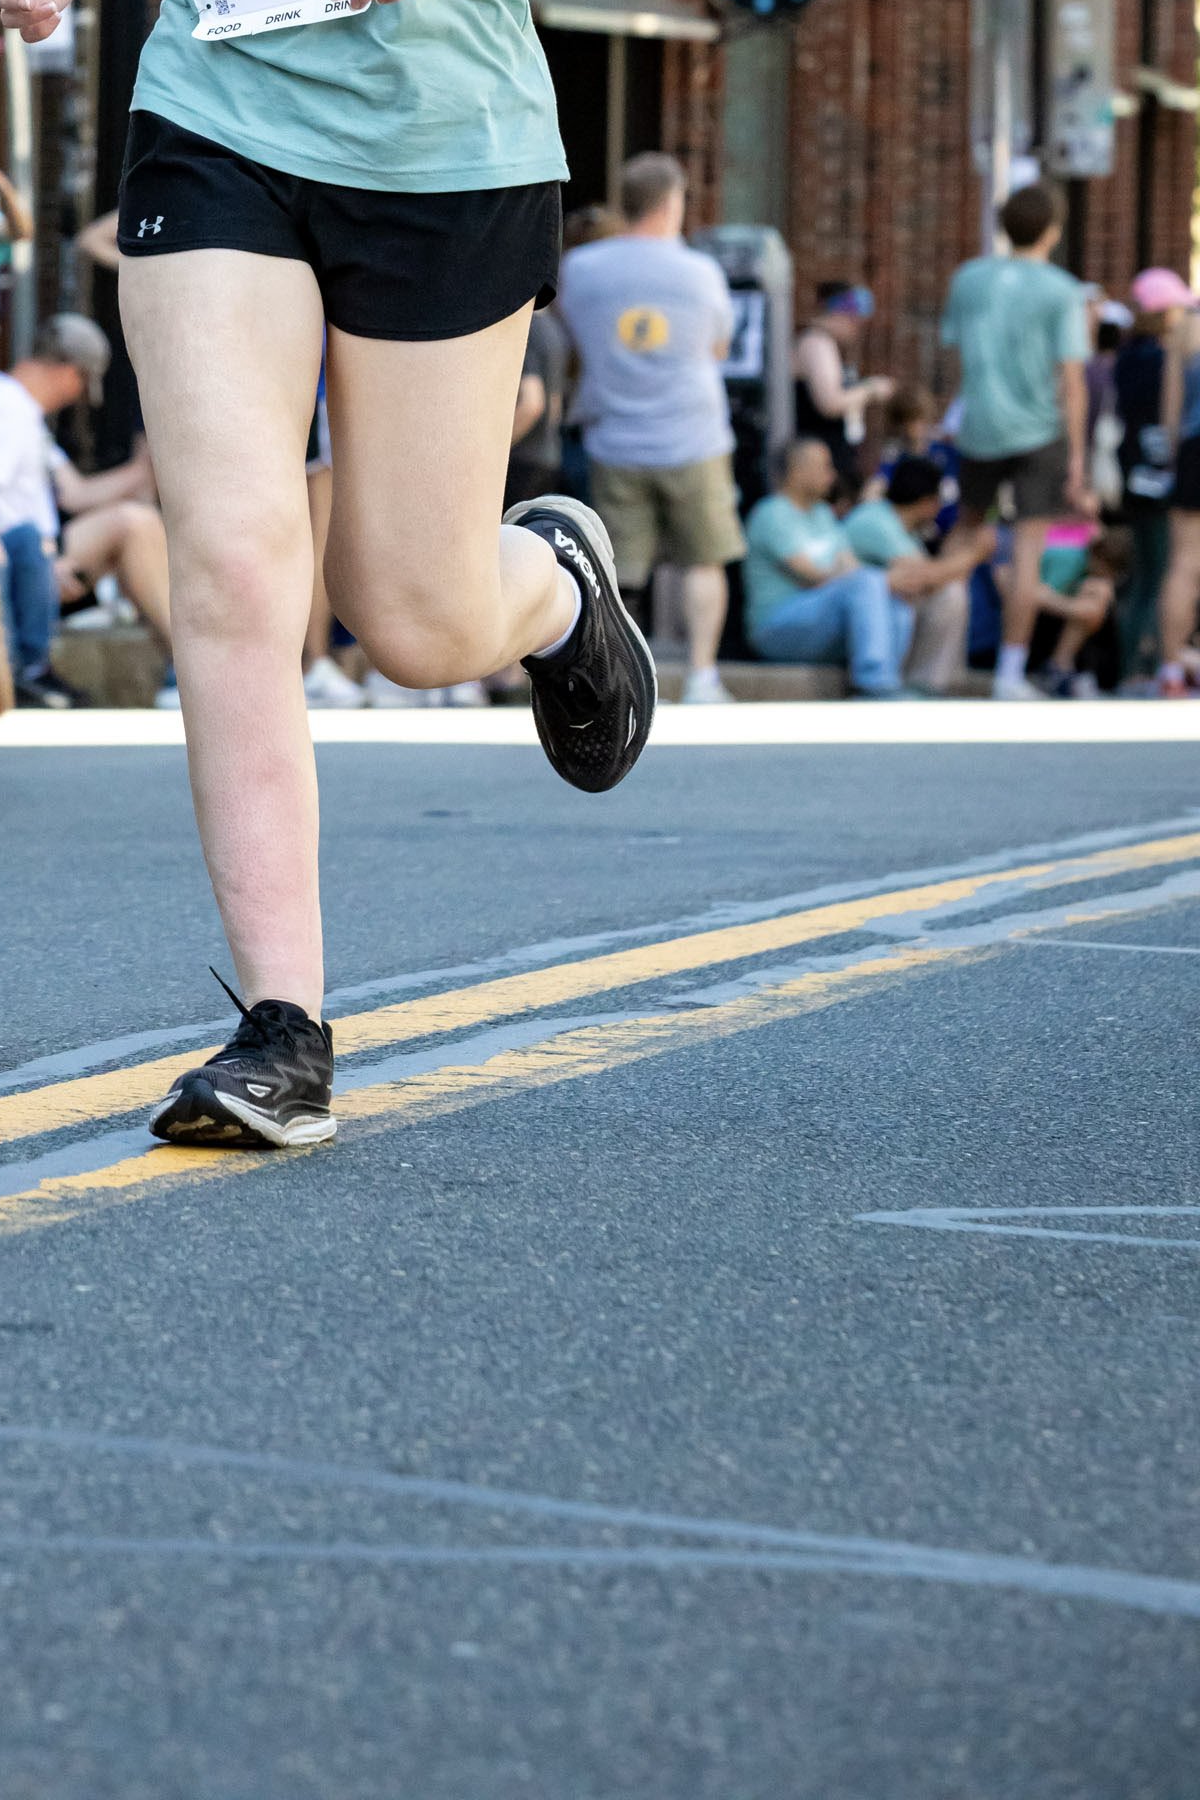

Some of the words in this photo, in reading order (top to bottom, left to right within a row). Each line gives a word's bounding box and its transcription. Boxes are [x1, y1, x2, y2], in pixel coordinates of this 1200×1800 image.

[206, 22, 242, 36] FOOD
[265, 9, 302, 25] DRINK
[324, 0, 352, 14] DRIN
[554, 527, 601, 599] HOKA
